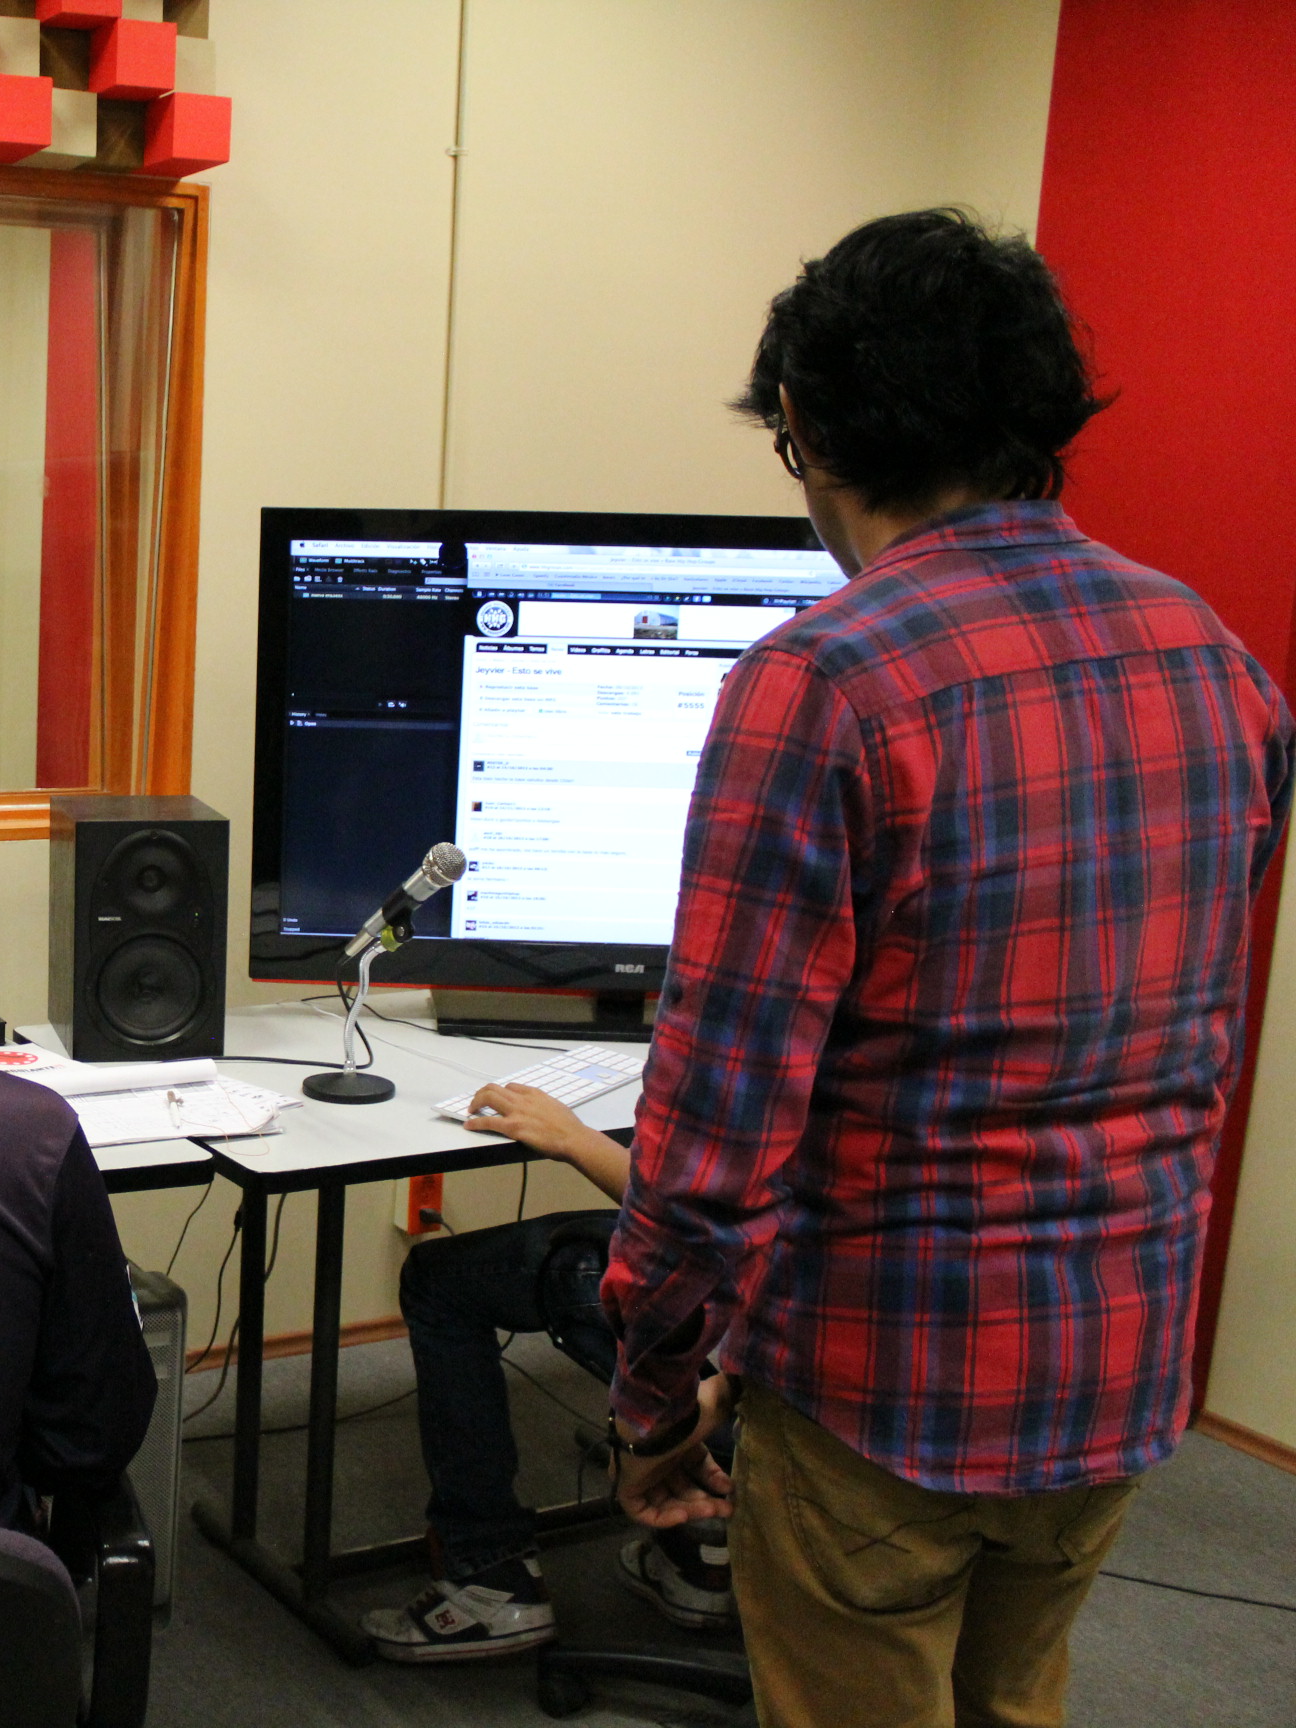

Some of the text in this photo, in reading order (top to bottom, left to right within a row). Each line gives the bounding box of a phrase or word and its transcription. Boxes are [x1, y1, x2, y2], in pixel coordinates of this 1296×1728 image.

[512, 666, 531, 675] Esto
[545, 667, 562, 675] vive
[614, 963, 645, 974] RCA
